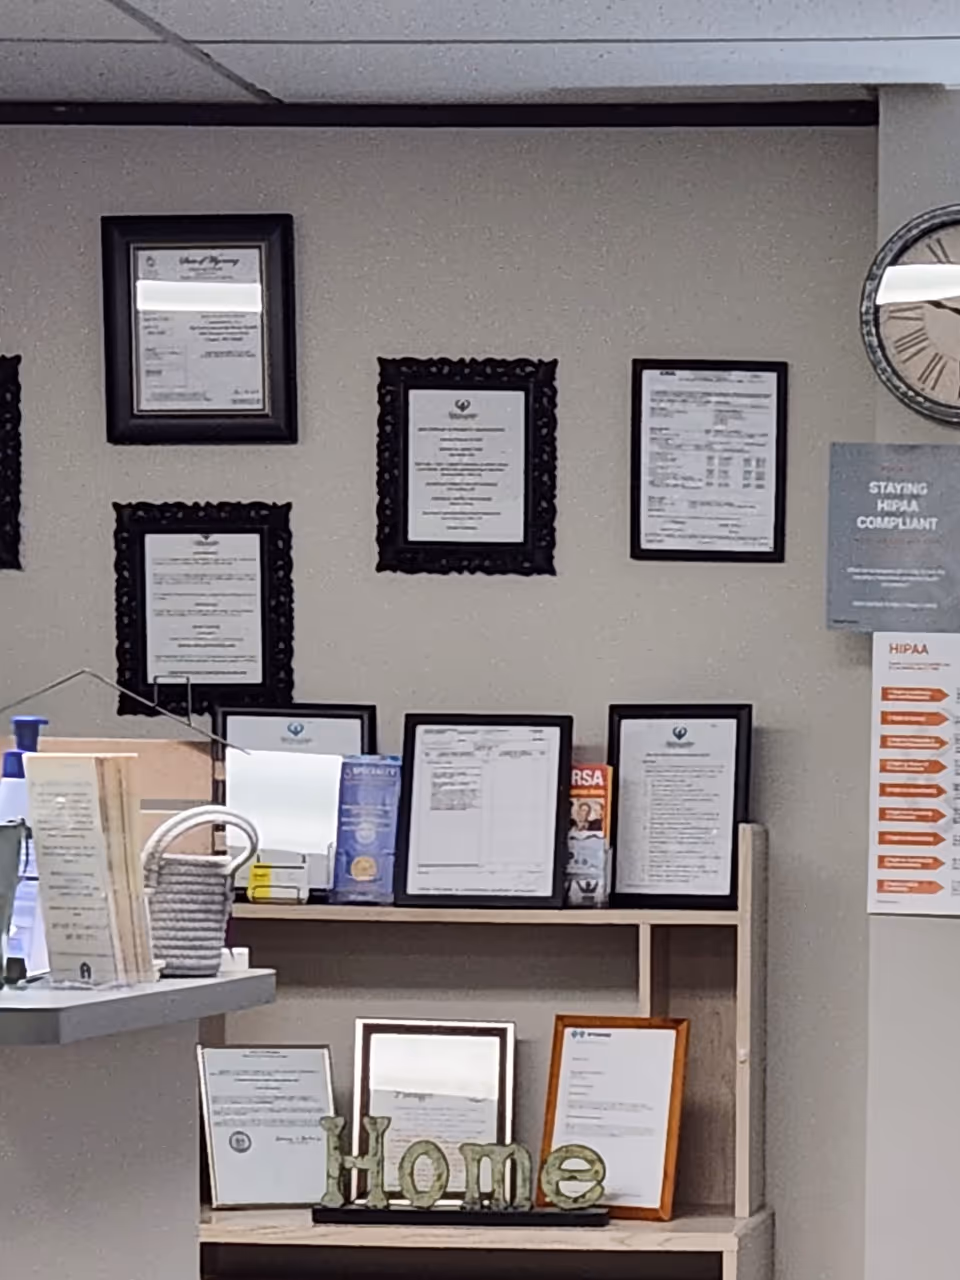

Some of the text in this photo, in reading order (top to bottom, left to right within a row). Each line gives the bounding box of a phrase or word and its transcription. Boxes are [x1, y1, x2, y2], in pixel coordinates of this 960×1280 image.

[868, 481, 929, 495] STAYING
[877, 499, 919, 512] HIPAA
[856, 516, 939, 531] COMPLIANT
[889, 643, 929, 655] HIPAA
[319, 1116, 606, 1211] Home
